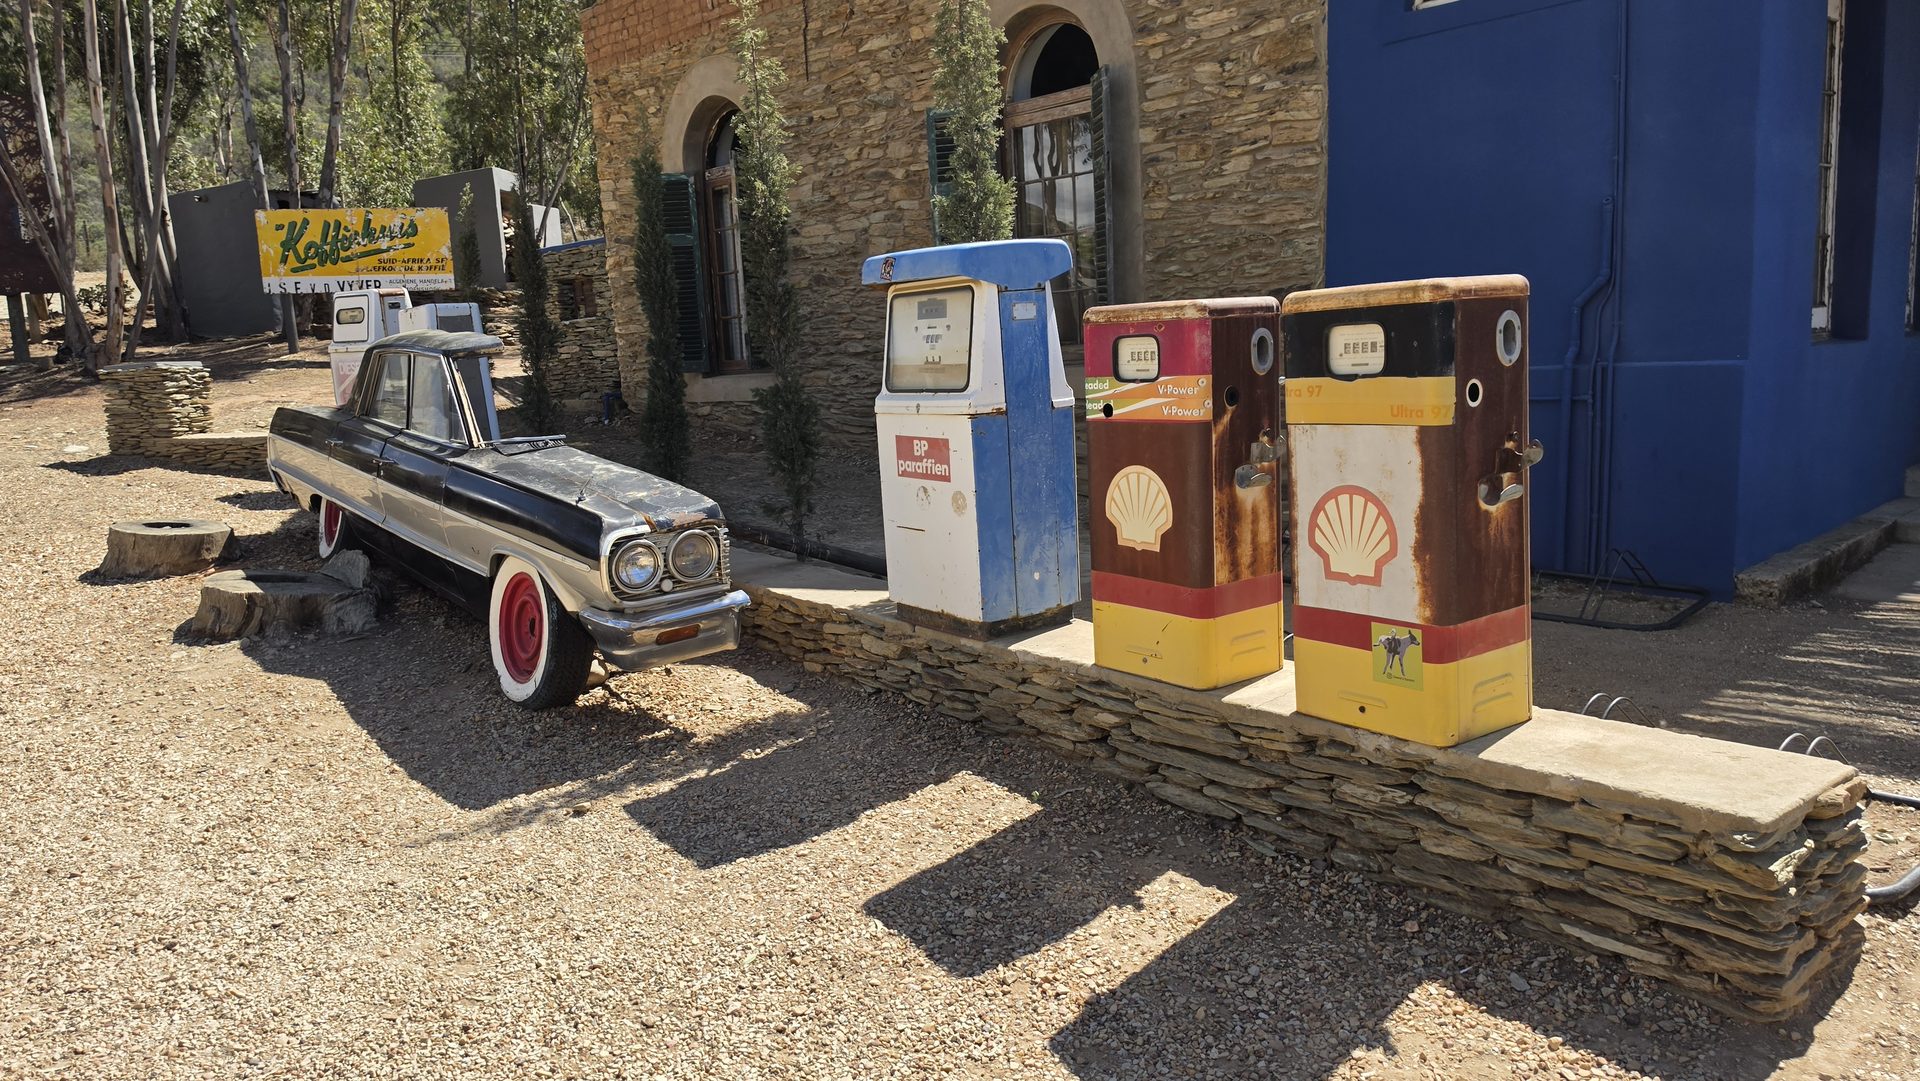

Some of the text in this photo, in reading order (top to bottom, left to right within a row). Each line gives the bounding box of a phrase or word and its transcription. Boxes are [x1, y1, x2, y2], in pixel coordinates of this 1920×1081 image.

[377, 257, 432, 265] SUID-AFRIKA
[1157, 384, 1200, 395] V-Power
[1306, 384, 1323, 398] 97
[1162, 405, 1206, 417] V-Power
[1390, 404, 1451, 419] Ultra 97
[913, 439, 929, 457] BP
[898, 458, 950, 476] paraffien
